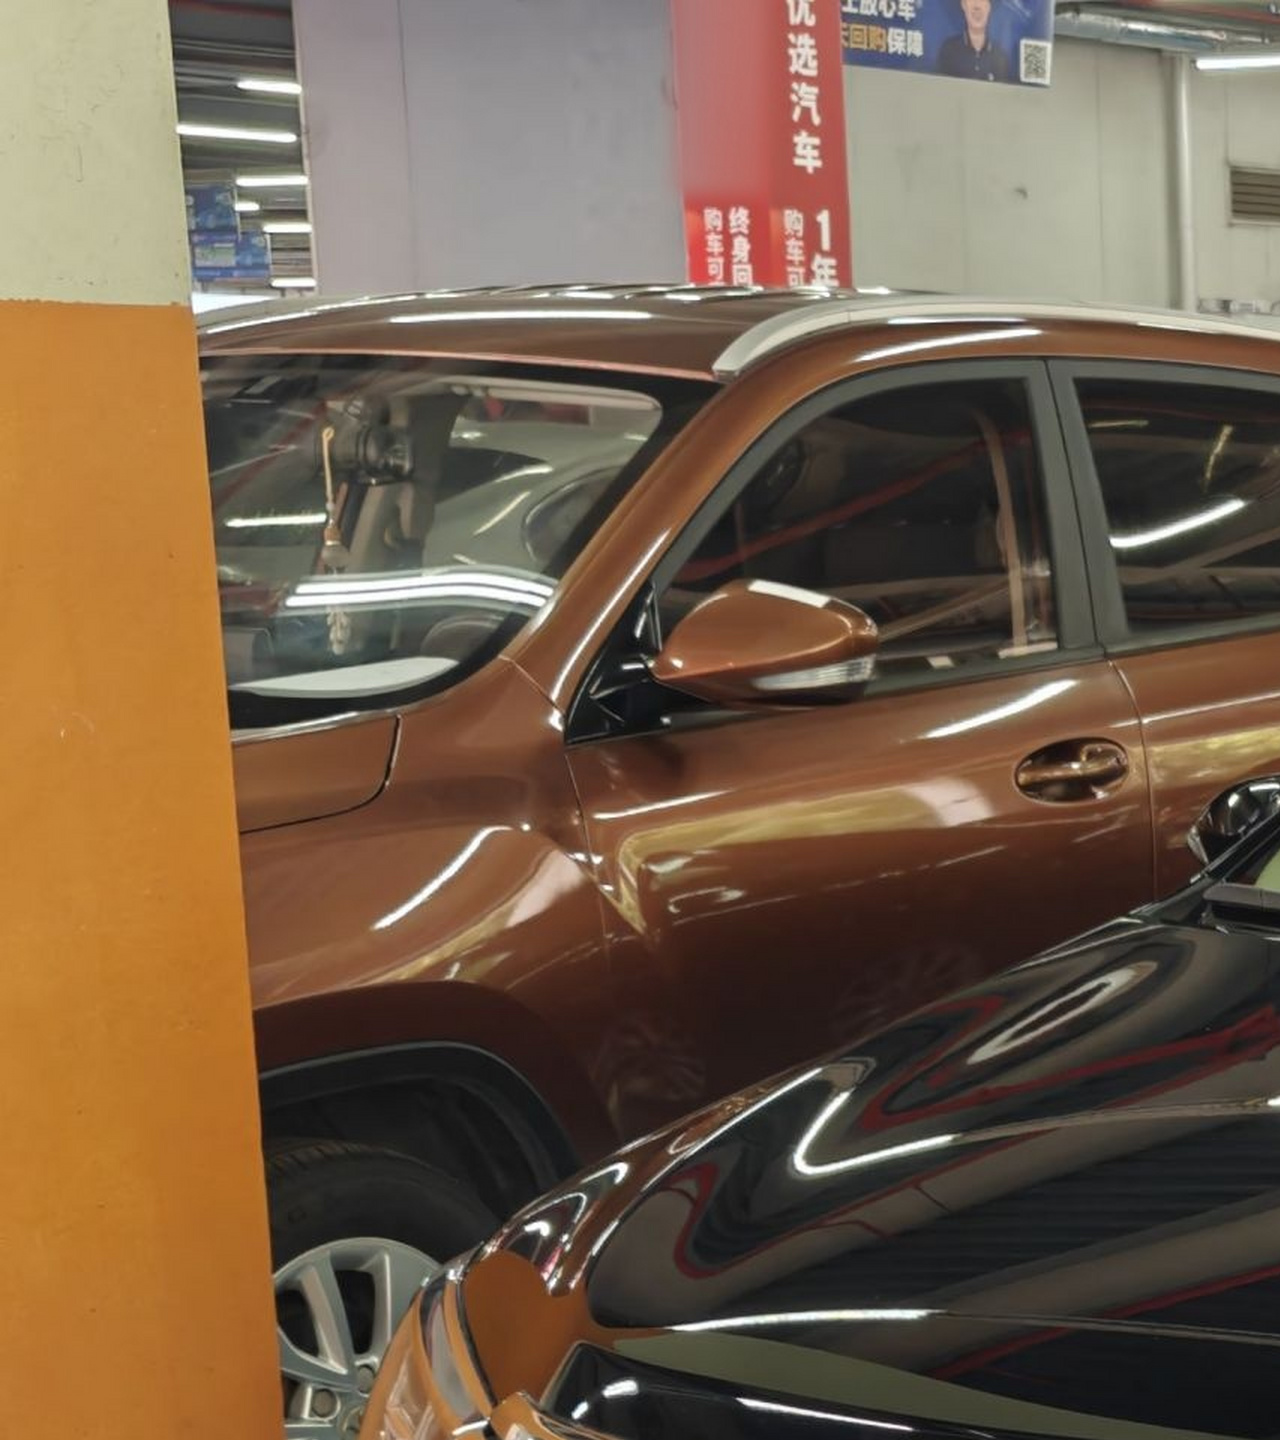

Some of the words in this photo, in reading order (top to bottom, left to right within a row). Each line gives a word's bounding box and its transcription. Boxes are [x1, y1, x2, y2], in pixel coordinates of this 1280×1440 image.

[786, 0, 823, 174] 优选汽车
[703, 206, 725, 286] 购车可
